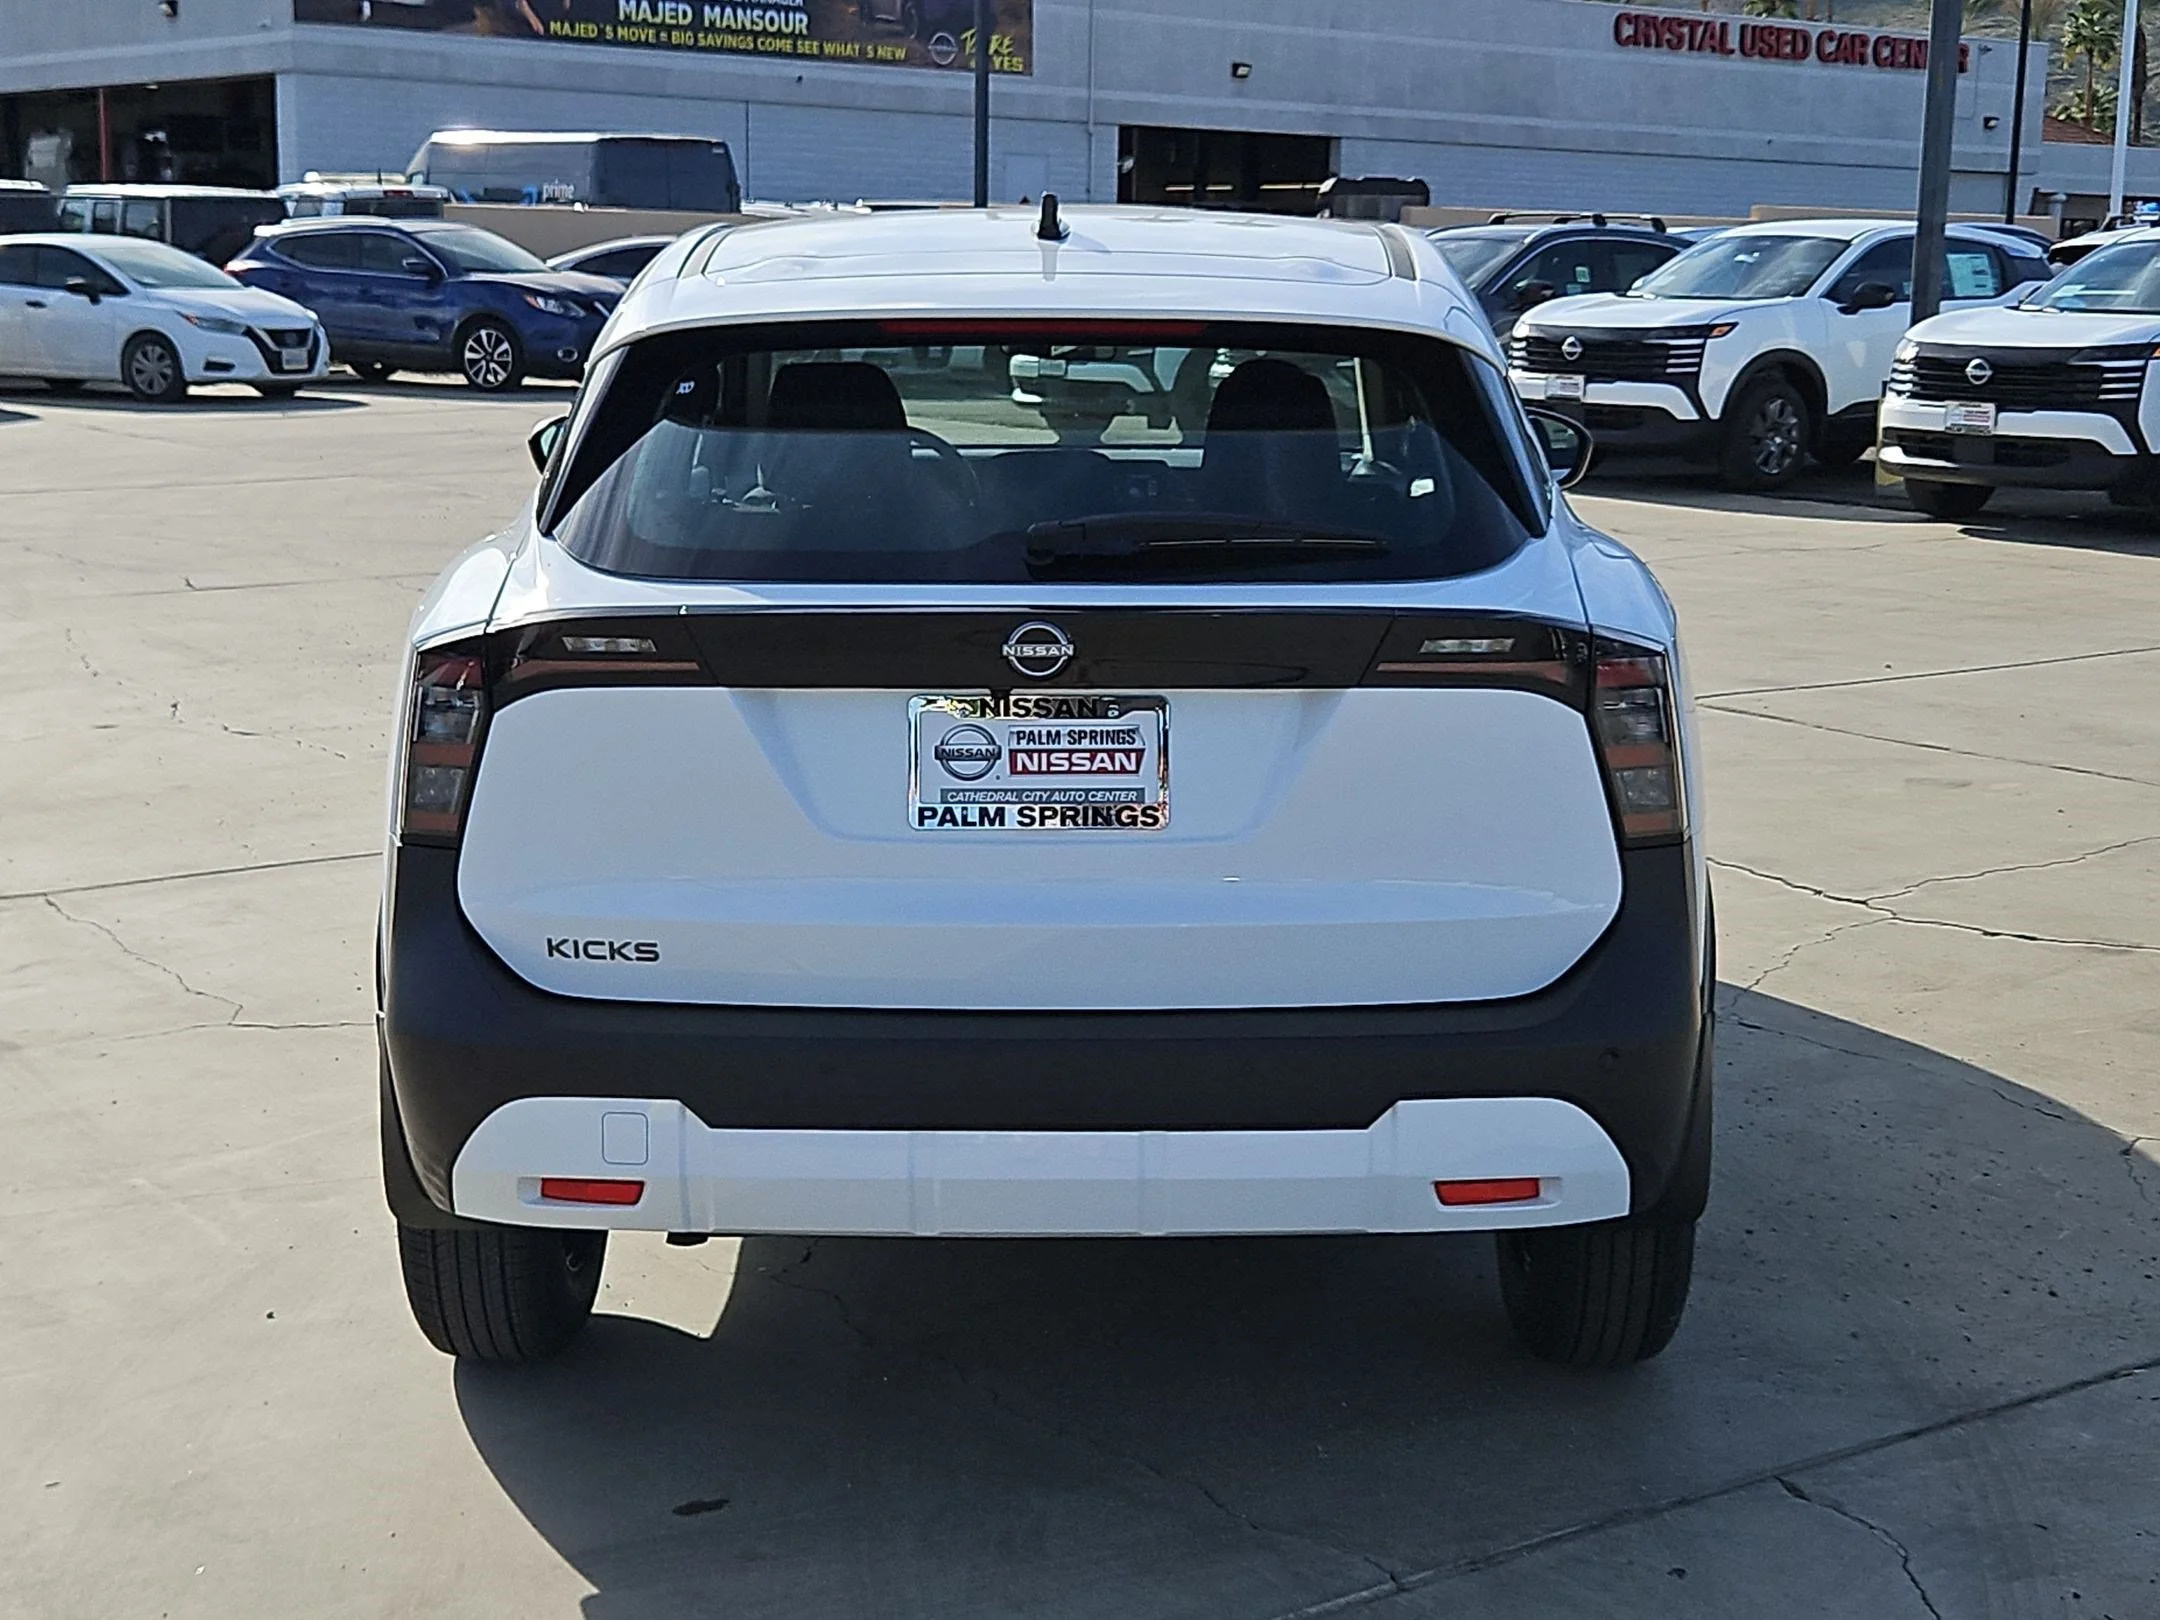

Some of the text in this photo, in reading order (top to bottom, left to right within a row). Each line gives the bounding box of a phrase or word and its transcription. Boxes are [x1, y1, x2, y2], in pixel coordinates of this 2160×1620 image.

[618, 0, 808, 35] MAJED MANSOUR
[617, 27, 656, 43] MOVE
[671, 30, 694, 46] BIG
[697, 32, 754, 51] SAVINGS
[757, 37, 794, 53] COME
[797, 40, 820, 55] SEE
[876, 45, 907, 60] NEW
[1614, 12, 1970, 73] CRYSTAL USED CAR CENR
[543, 178, 576, 202] prime
[1002, 643, 1075, 657] NISSAN
[979, 697, 1099, 719] NISSAN
[1015, 729, 1137, 747] PALM SPRINGS
[940, 747, 998, 759] NISSAN
[1016, 752, 1137, 773] NISSAN
[947, 791, 1138, 803] CATHEDRAL CITY AUTO CENTER
[917, 805, 1161, 828] PALM SPRINGS
[546, 937, 660, 963] KICKS
